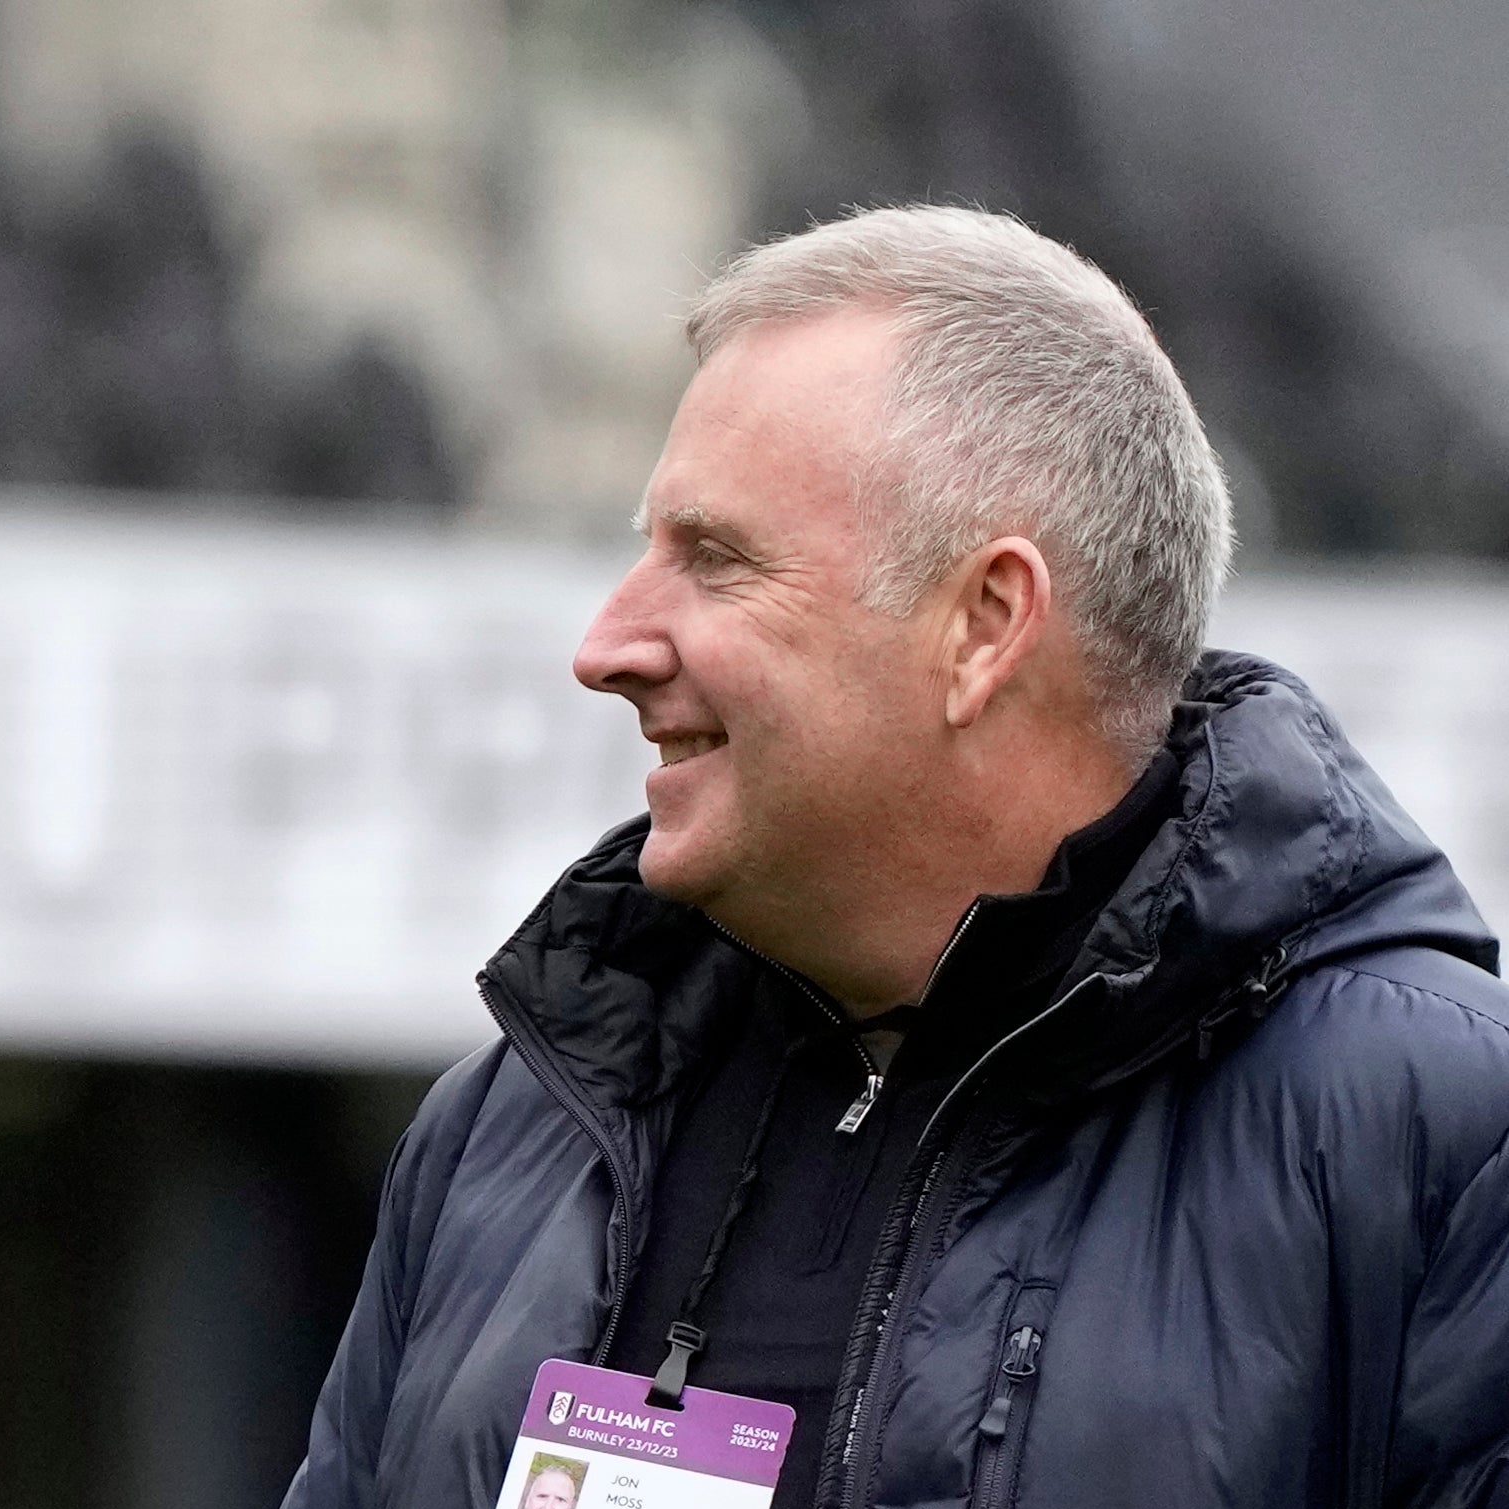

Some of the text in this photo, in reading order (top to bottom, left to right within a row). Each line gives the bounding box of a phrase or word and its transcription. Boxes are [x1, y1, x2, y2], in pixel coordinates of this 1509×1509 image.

[576, 1404, 676, 1437] FULHAM FC
[732, 1423, 779, 1441] SEASON
[568, 1426, 678, 1459] BURNLEY 23/12/23
[730, 1434, 776, 1452] 2023/24
[611, 1475, 640, 1489] JON
[606, 1493, 643, 1509] MOSS
